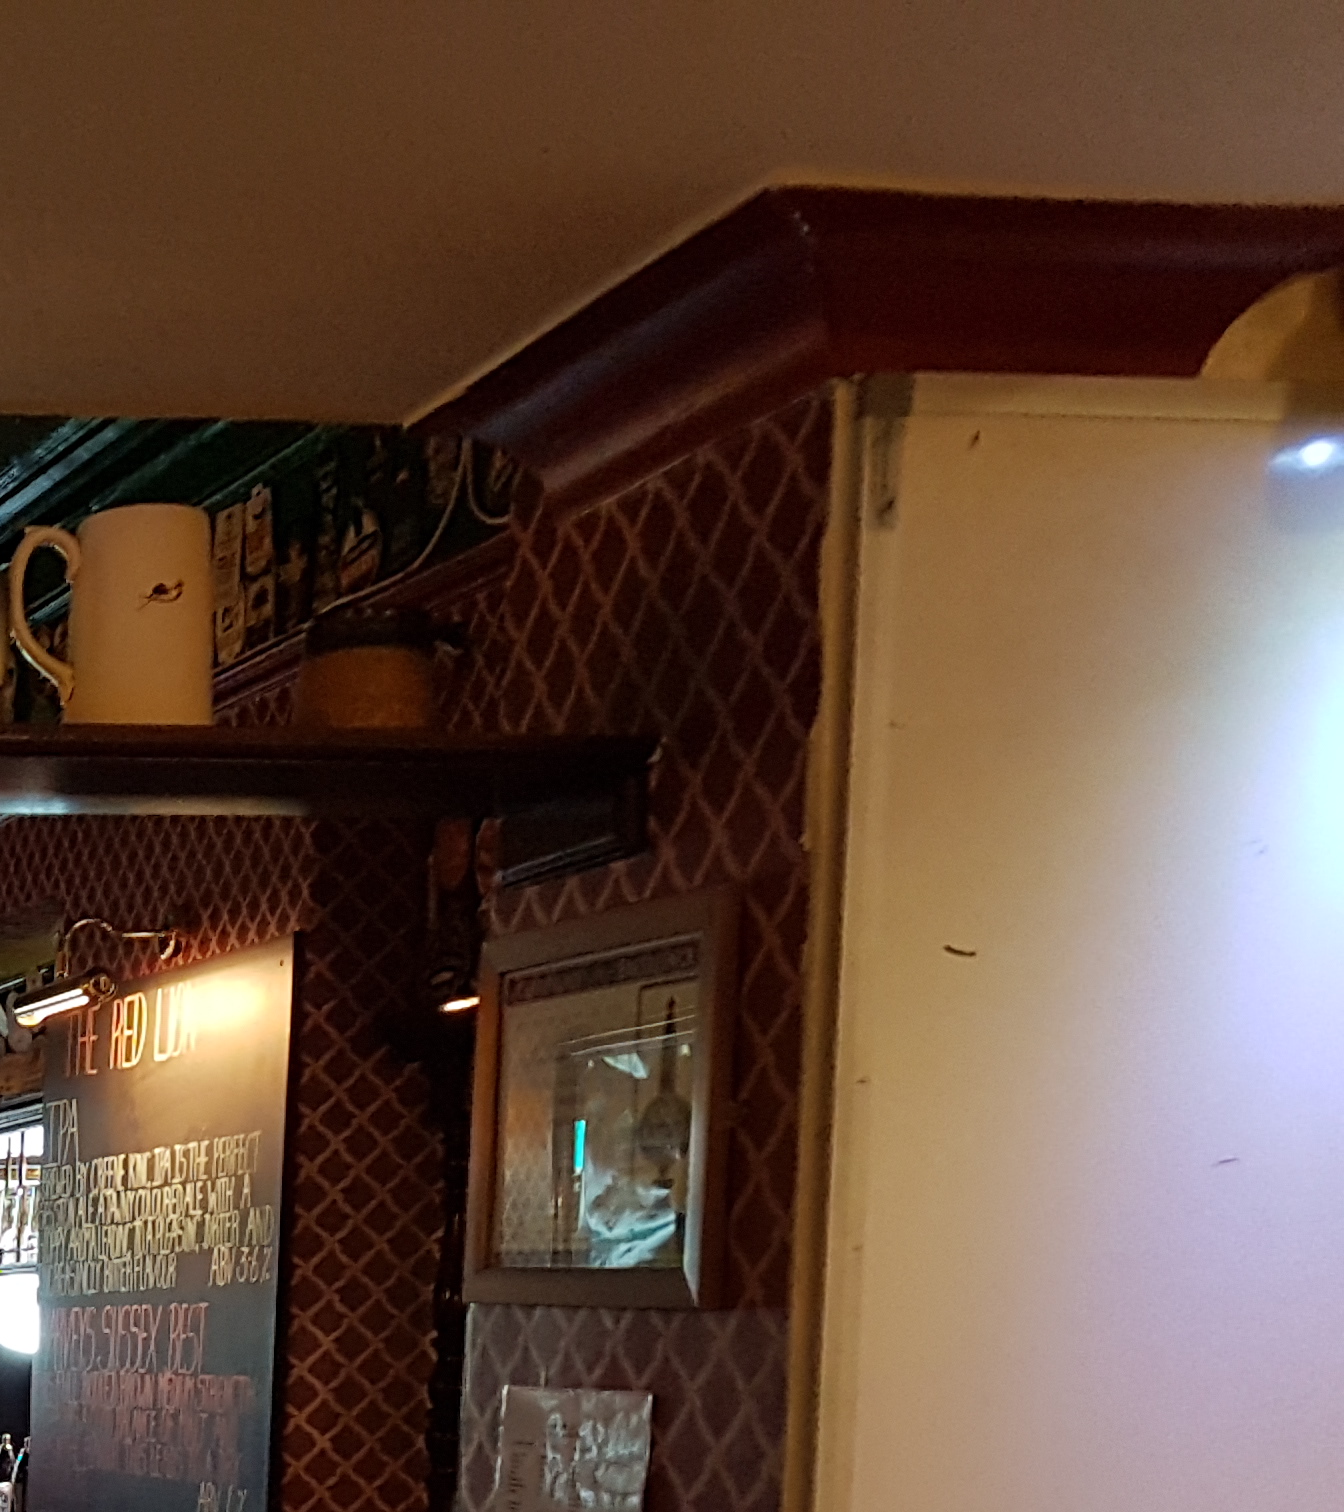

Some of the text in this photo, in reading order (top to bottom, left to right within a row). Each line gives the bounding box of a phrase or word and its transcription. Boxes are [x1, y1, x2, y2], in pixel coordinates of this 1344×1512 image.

[110, 992, 148, 1070] RED
[211, 1130, 262, 1178] PERFECT
[240, 1173, 251, 1208] A
[245, 1204, 274, 1246] AND
[208, 1246, 236, 1287] ABV
[97, 1305, 162, 1373] SUSSEX
[168, 1302, 210, 1375] BEST
